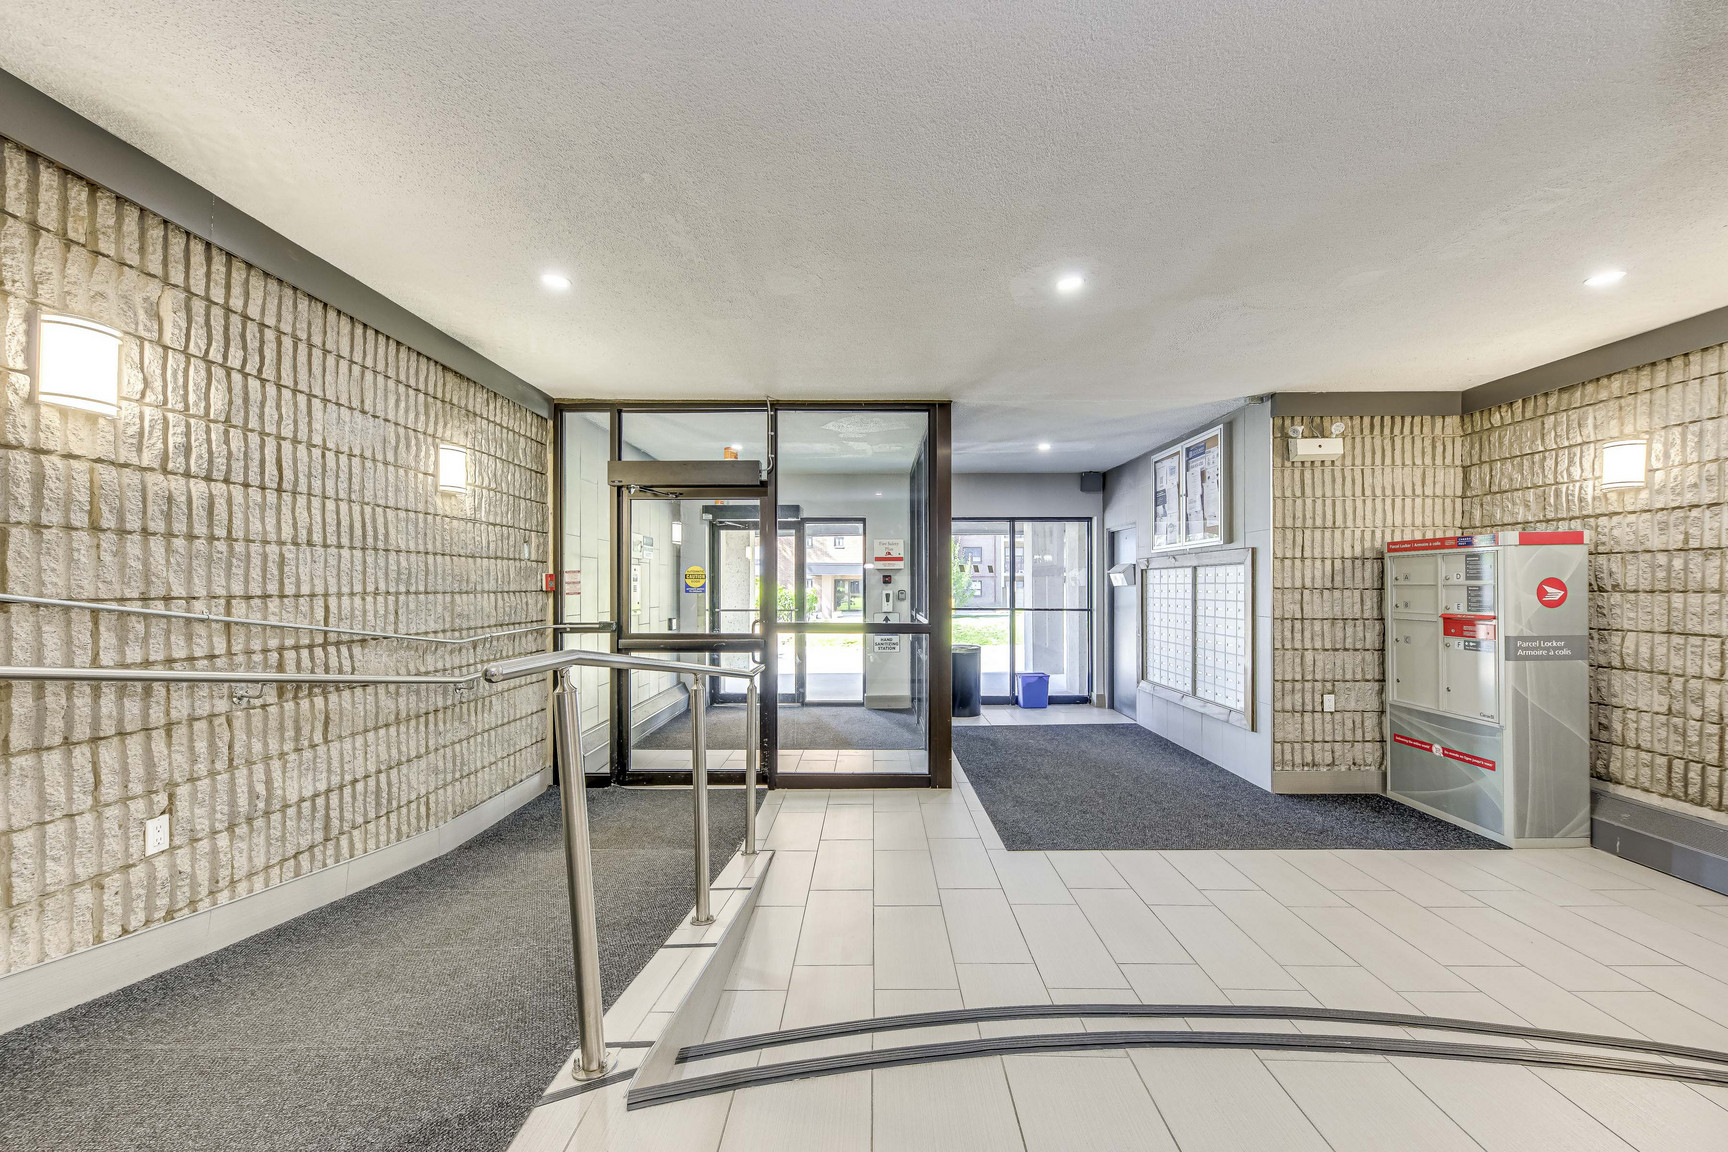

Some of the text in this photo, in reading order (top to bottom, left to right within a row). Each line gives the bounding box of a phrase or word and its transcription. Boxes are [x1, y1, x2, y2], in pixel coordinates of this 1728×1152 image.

[1517, 640, 1565, 648] Parcel Locker
[1549, 648, 1554, 656] à
[1555, 648, 1572, 656] colis
